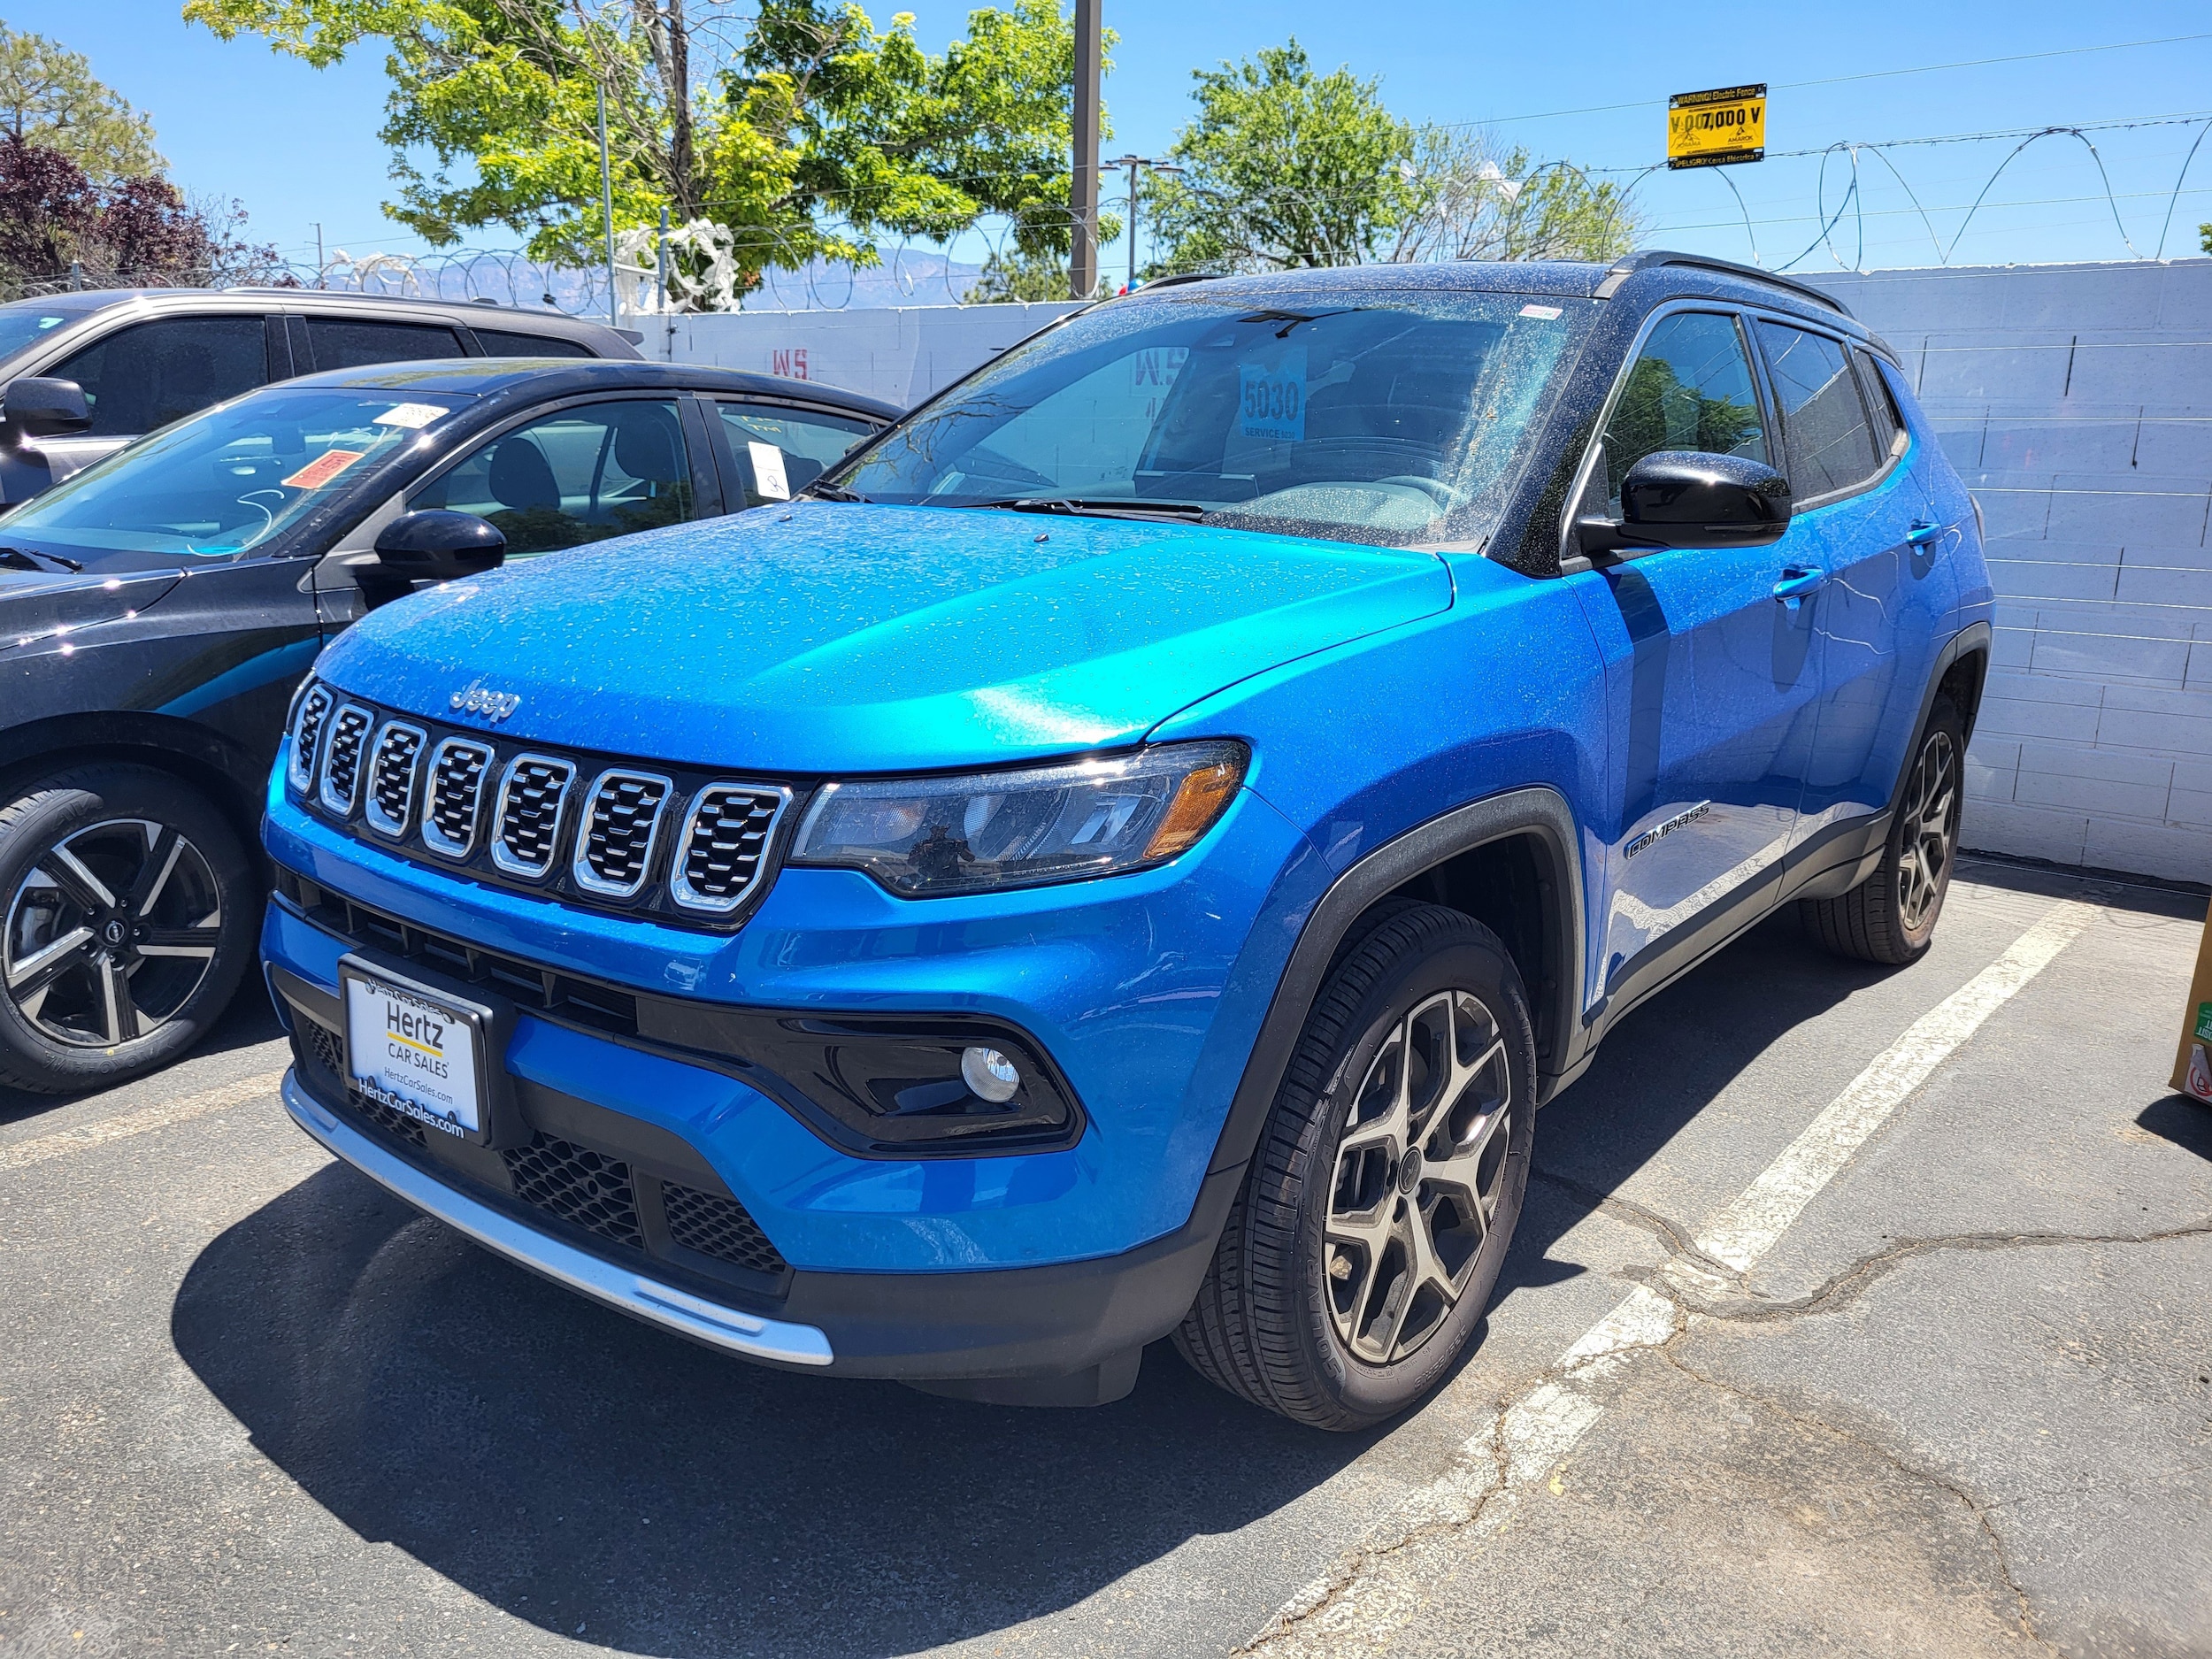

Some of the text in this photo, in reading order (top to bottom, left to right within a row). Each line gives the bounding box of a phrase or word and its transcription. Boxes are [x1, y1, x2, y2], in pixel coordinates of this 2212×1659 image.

[1244, 380, 1299, 421] 5030
[1245, 426, 1279, 439] SERVICE
[449, 679, 520, 723] Jeep
[1624, 801, 1710, 859] COMPASS
[387, 1001, 443, 1049] Hertz
[388, 1042, 448, 1079] CAR SALES
[384, 1067, 453, 1105] HertzCarSales.com
[358, 1078, 465, 1139] HertzCarSales.com
